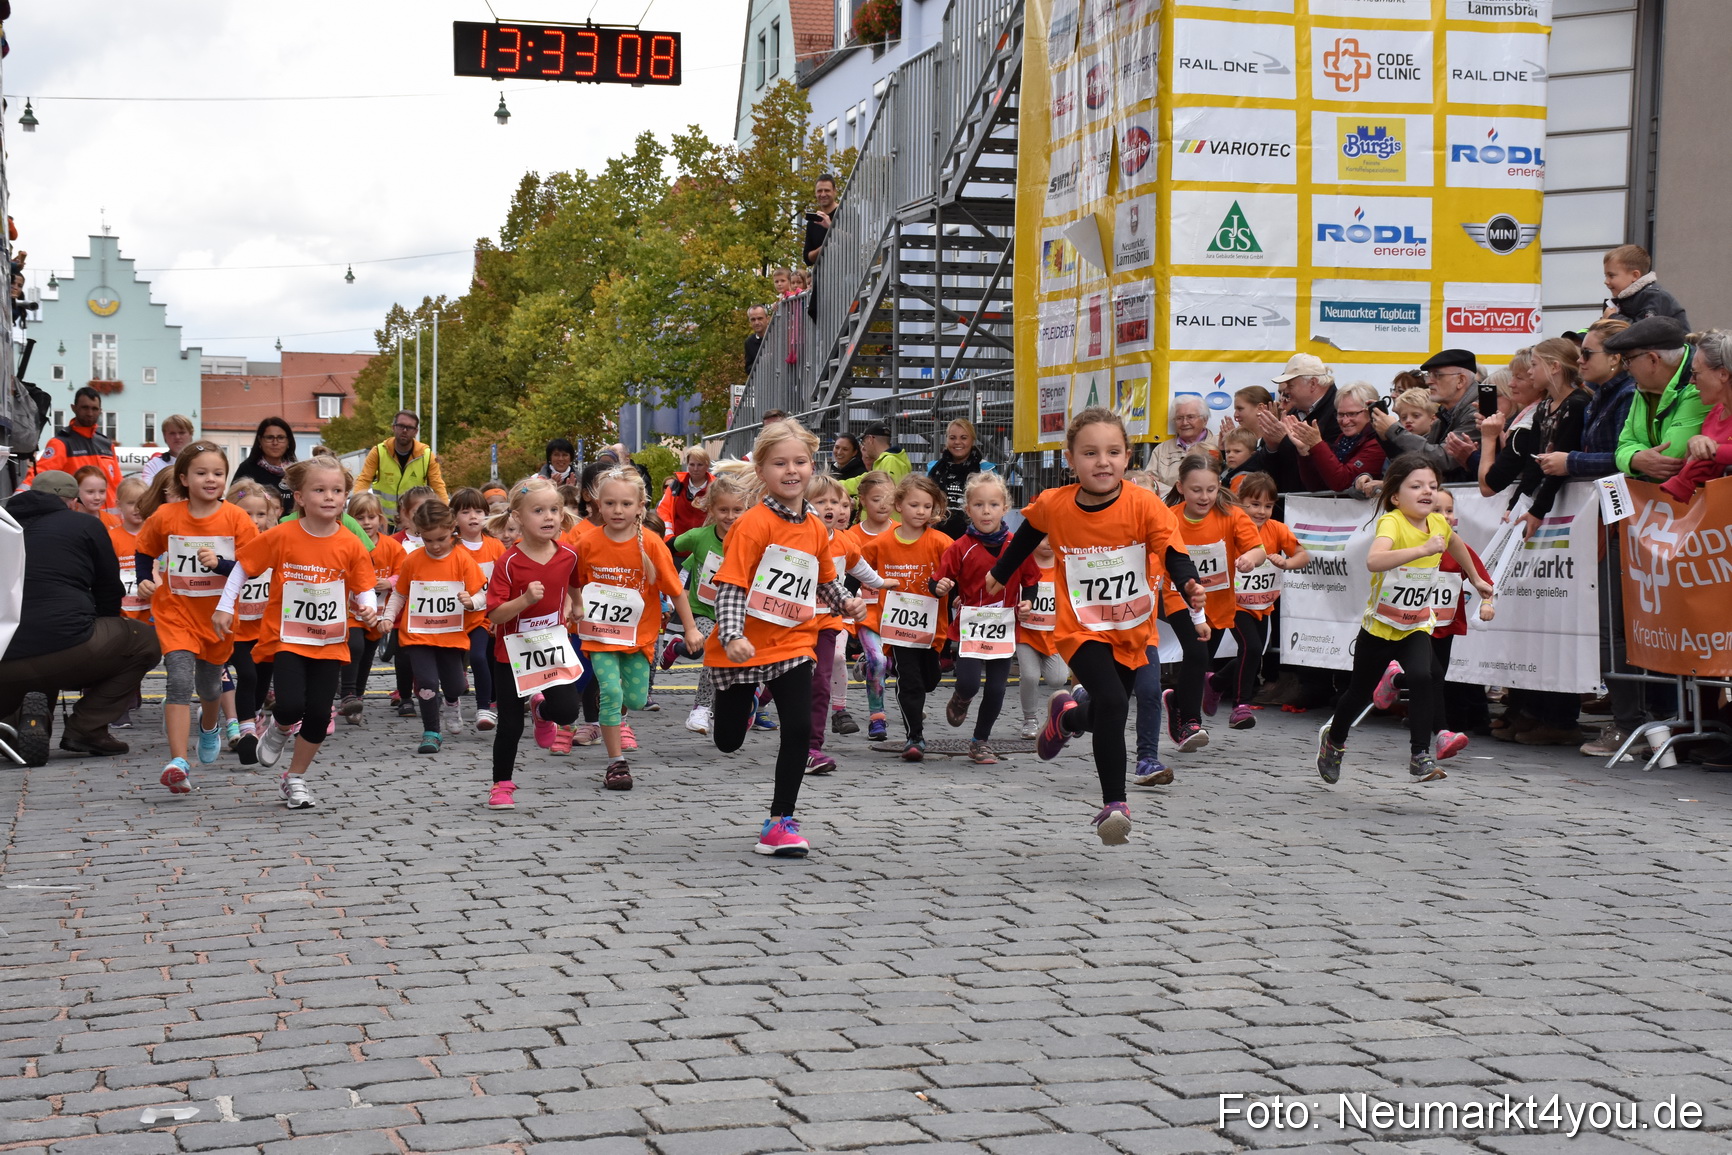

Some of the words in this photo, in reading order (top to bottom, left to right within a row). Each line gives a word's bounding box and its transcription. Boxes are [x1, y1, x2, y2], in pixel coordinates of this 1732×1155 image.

[481, 28, 598, 76] 13:33
[617, 34, 675, 79] 08
[1377, 53, 1414, 67] CODE
[1179, 58, 1259, 74] RAIL.ONE
[1377, 67, 1421, 80] CLINIC
[1452, 69, 1528, 82] RAIL.ONE
[1210, 141, 1291, 158] VARIOTEC
[1343, 135, 1402, 159] Burgis
[1489, 229, 1517, 240] MINI
[1374, 244, 1427, 257] energie
[1324, 306, 1377, 319] Neumarkter
[1378, 307, 1416, 321] Tagblatt
[1450, 306, 1525, 327] charivari
[1176, 315, 1258, 327] RAIL.ONE
[1391, 325, 1407, 333] lebe
[1610, 489, 1623, 516] swn
[282, 562, 328, 574] Neumarkter
[1096, 556, 1124, 568] BOCK
[189, 579, 211, 587] Emma
[283, 571, 318, 583] Stadtlauf
[1241, 572, 1276, 591] 7357
[766, 567, 812, 601] 7214
[1079, 570, 1139, 602] 7272
[1238, 594, 1275, 605] MELISSA
[1535, 587, 1568, 599] genießen
[293, 600, 337, 622] 7032
[416, 597, 456, 613] 7105
[588, 600, 633, 623] 7132
[762, 596, 802, 620] EMILY
[890, 607, 928, 629] 7034
[1101, 602, 1137, 622] LEA
[1402, 612, 1418, 621] Nora
[530, 618, 549, 628] DEHN
[307, 626, 327, 635] Paula
[592, 625, 621, 635] Franziska
[895, 629, 917, 640] Patricia
[968, 621, 1007, 640] 7129
[980, 643, 993, 651] Anna
[519, 645, 566, 671] 7077
[543, 669, 558, 680] Leni
